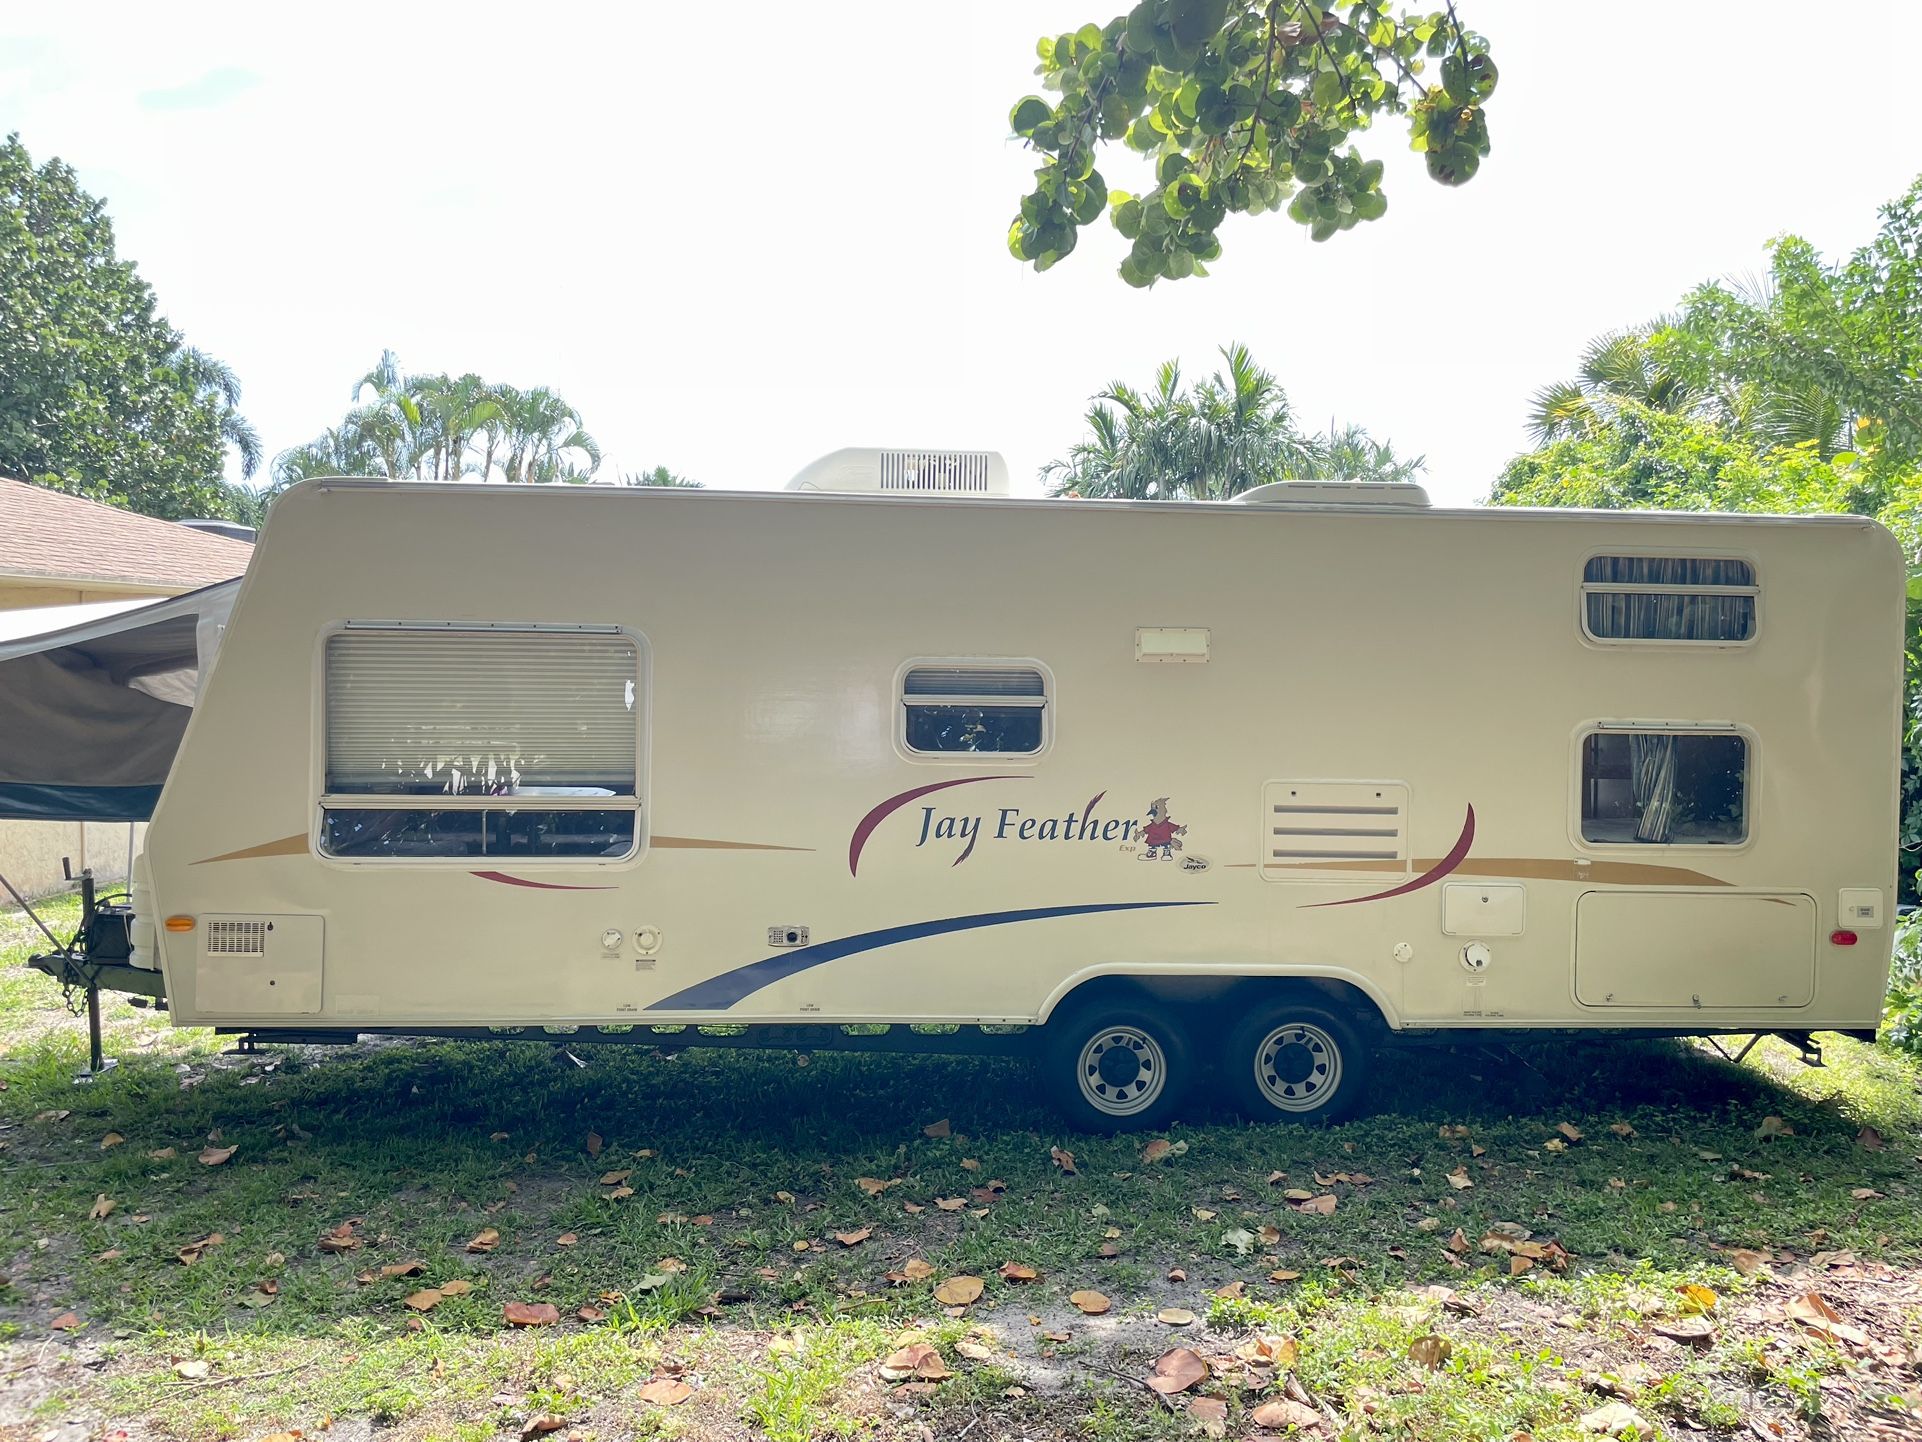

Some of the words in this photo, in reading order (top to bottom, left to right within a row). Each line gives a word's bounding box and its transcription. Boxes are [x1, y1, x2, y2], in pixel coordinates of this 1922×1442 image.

[915, 806, 982, 868] Jay
[993, 789, 1138, 841] Feather
[1183, 863, 1207, 871] Jayco
